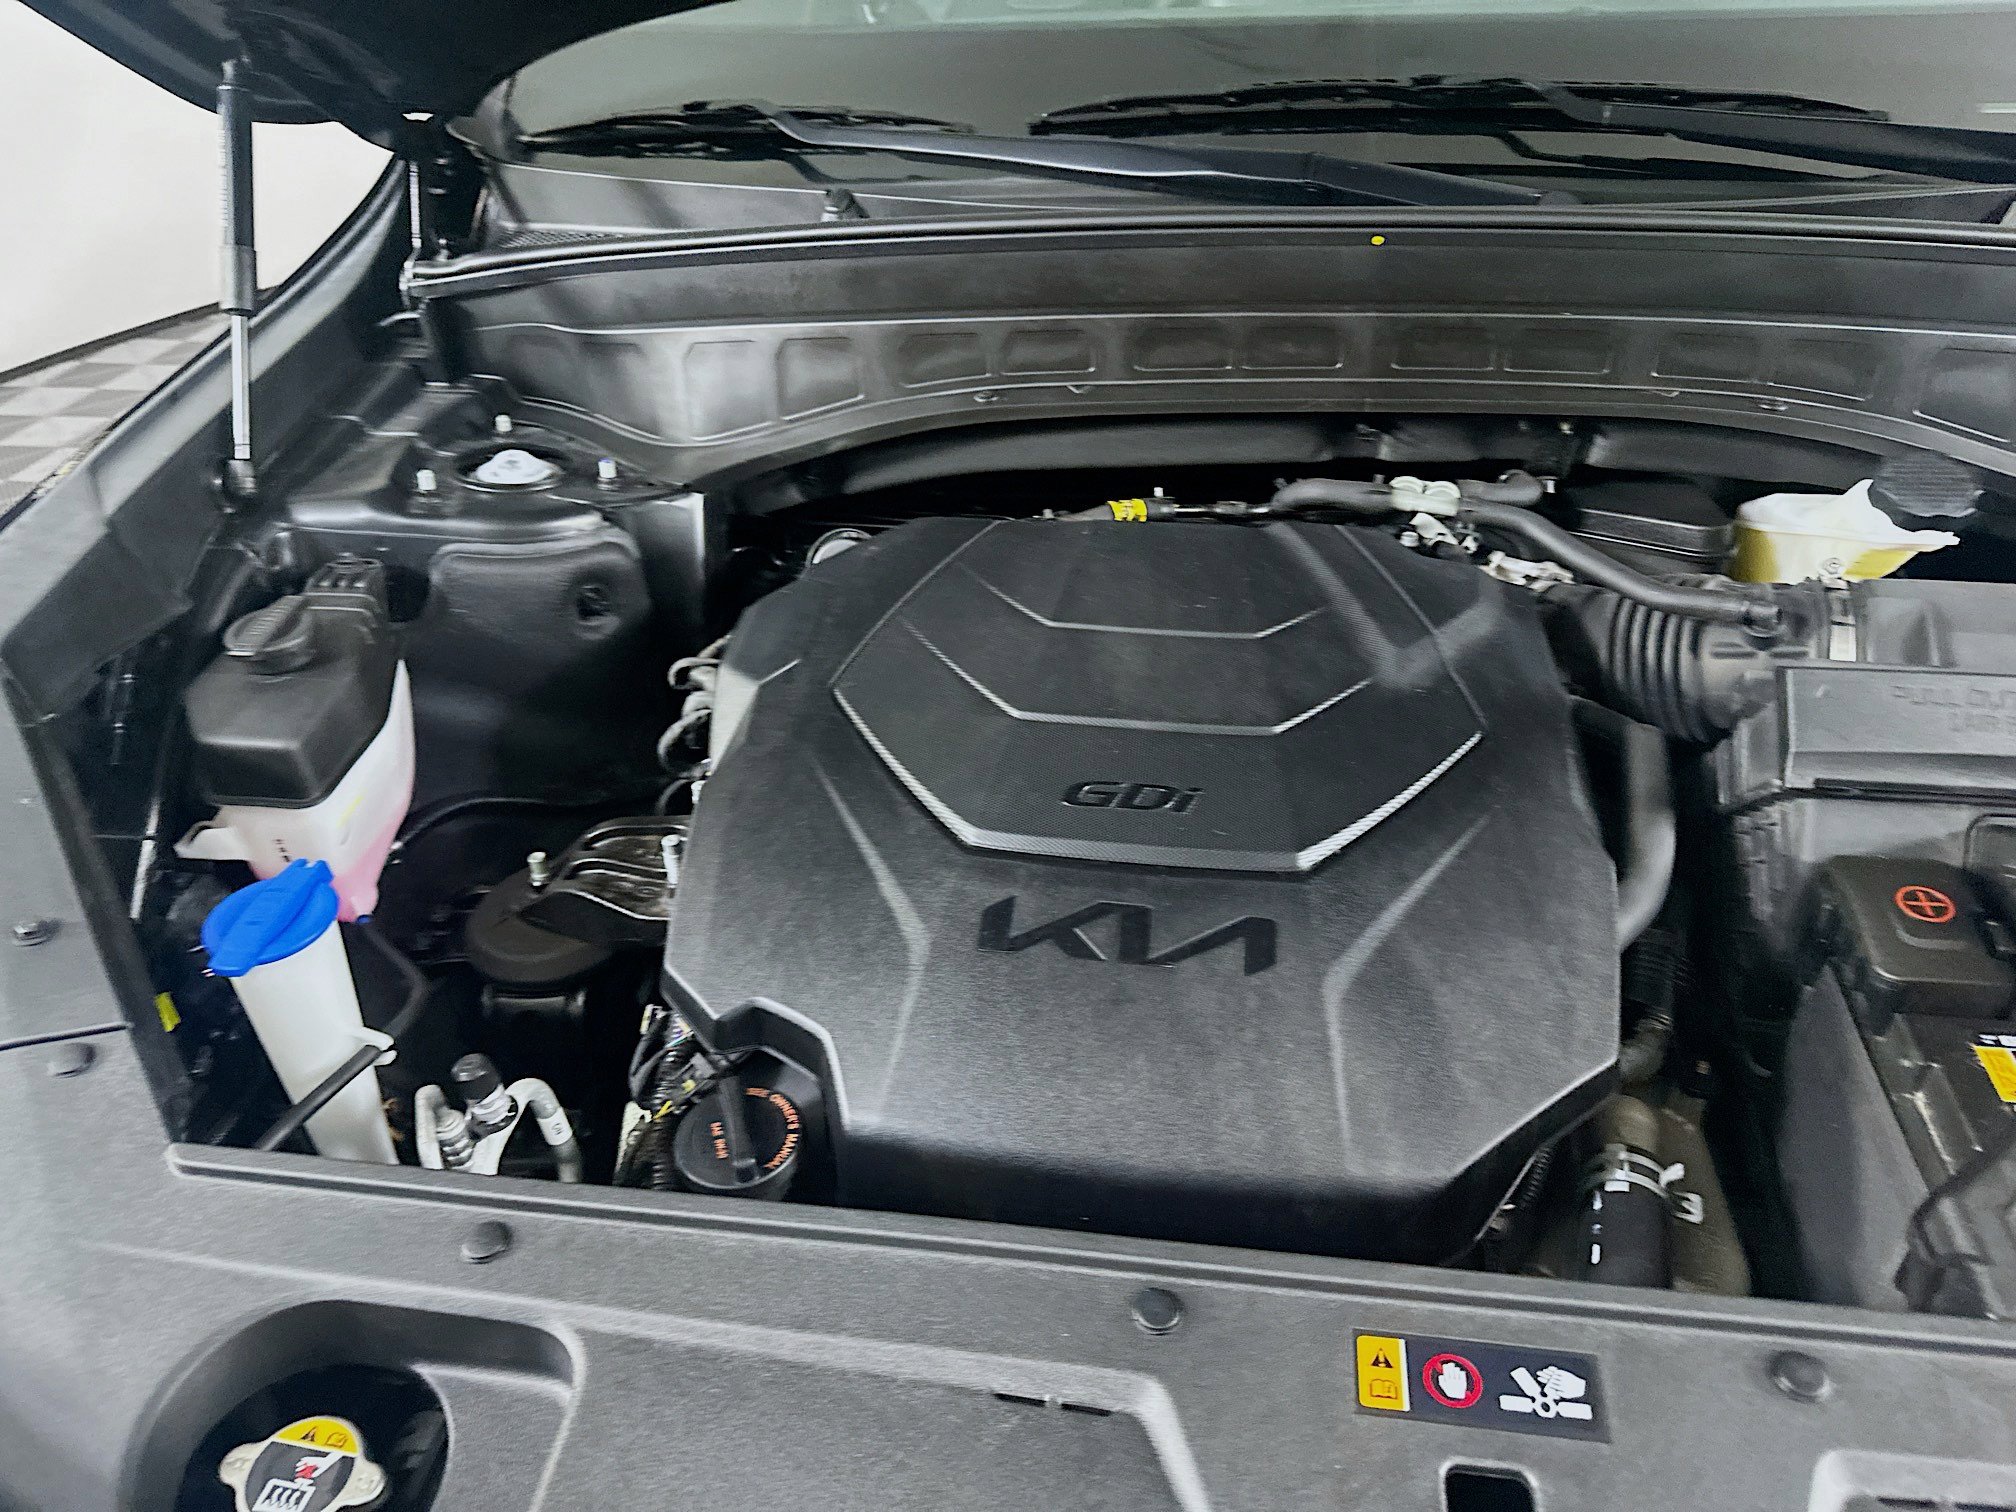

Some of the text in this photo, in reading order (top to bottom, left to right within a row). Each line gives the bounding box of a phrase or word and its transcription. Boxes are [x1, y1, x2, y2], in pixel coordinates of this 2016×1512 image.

[1061, 781, 1205, 815] GDi
[978, 895, 1278, 976] KIA
[768, 1093, 800, 1130] OWNER'S
[763, 1133, 799, 1169] MANUAL
